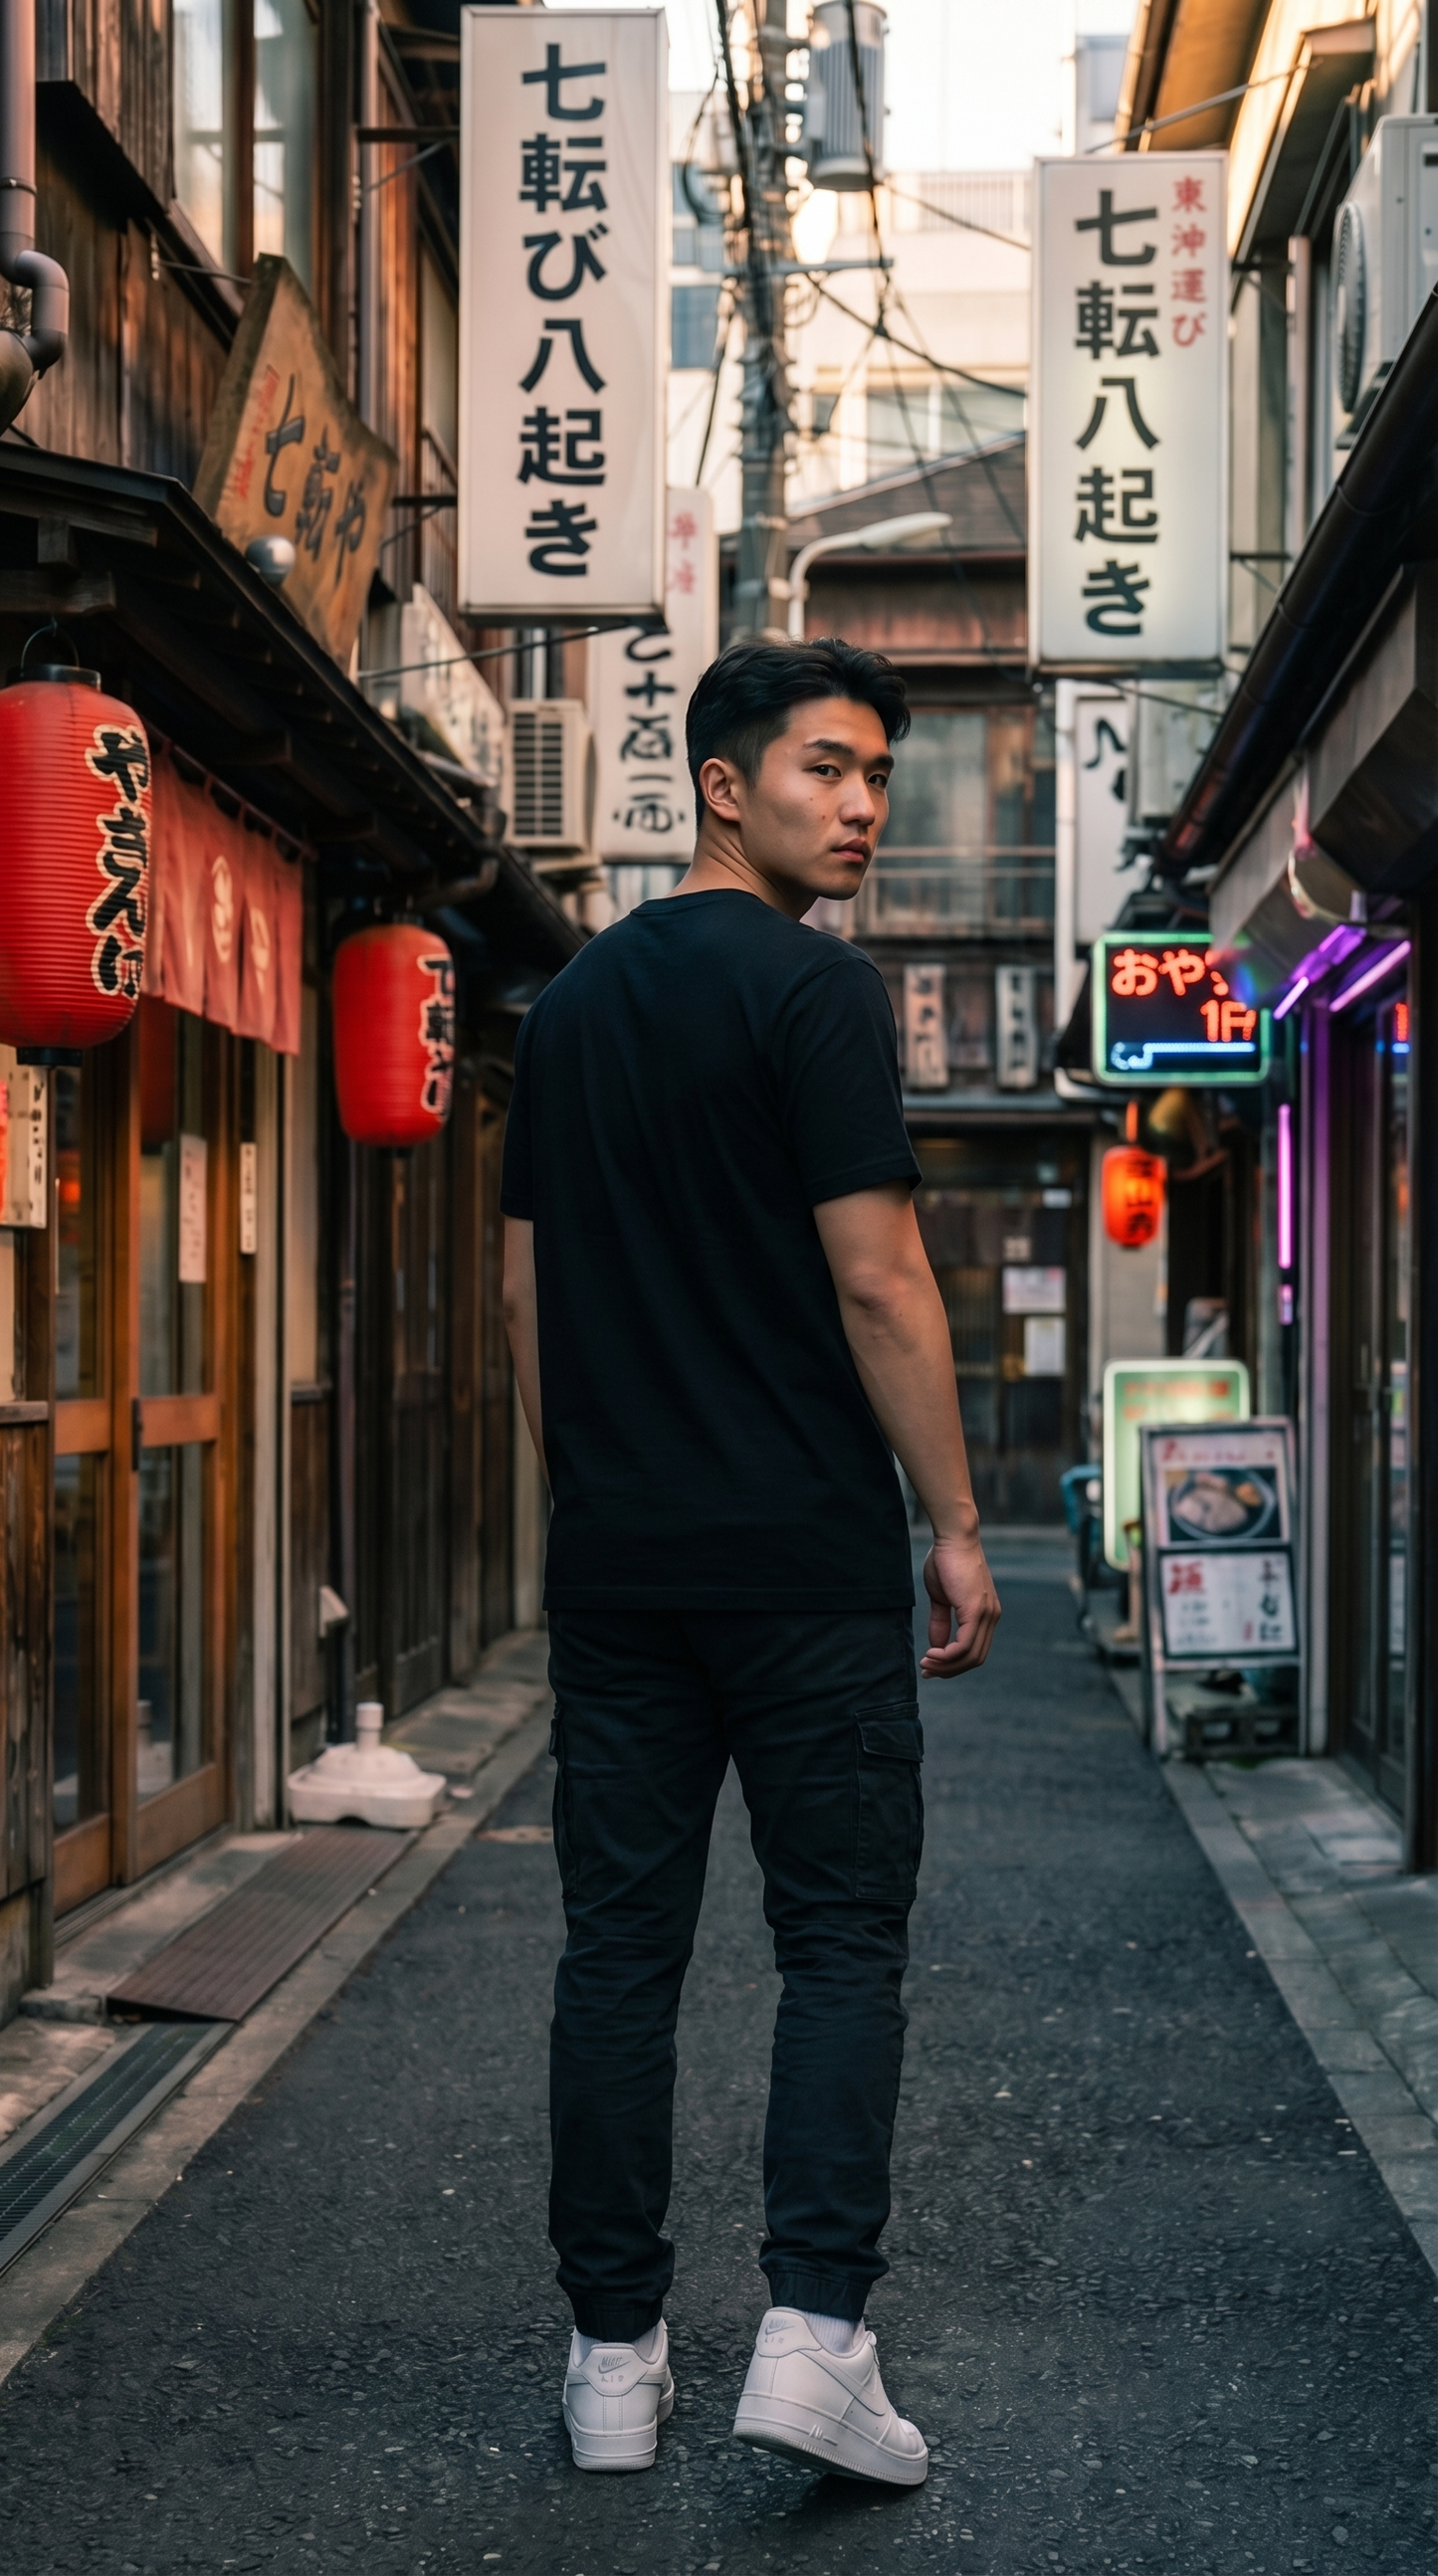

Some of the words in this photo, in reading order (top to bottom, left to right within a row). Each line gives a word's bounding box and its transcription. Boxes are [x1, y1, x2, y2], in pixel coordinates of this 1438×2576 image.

[517, 43, 608, 576] 七転び八起き
[1074, 189, 1161, 635] 七転八起き
